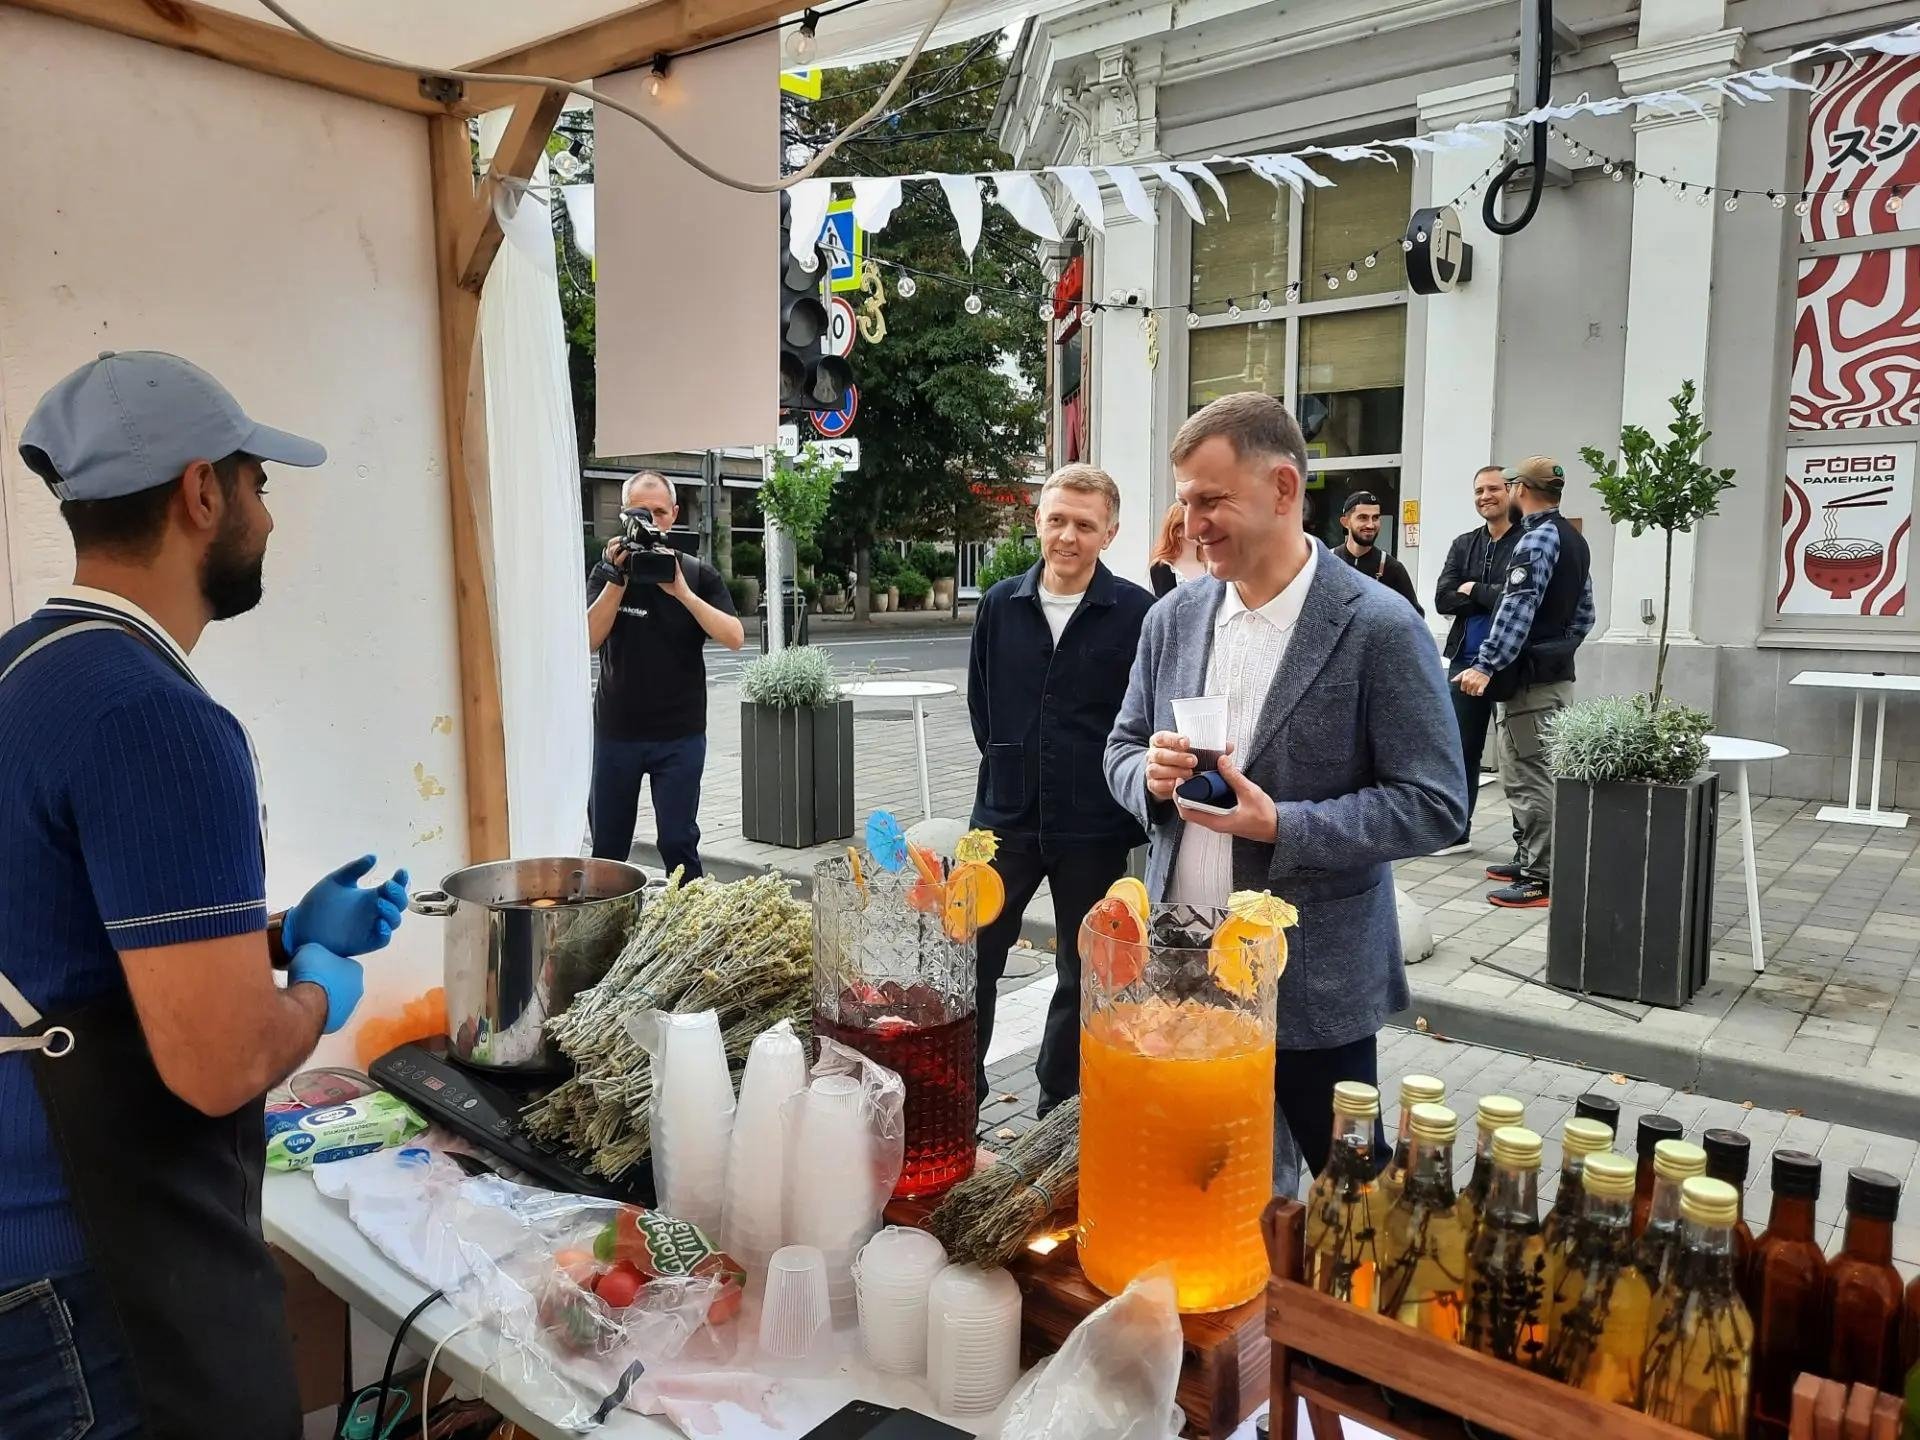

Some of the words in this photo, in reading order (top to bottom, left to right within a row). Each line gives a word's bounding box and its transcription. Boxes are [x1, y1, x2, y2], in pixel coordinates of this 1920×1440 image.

[1827, 125, 1919, 170] スシ
[1803, 473, 1896, 485] РАМЕННАЯ
[286, 1136, 313, 1147] AURA
[287, 1156, 310, 1168] 120
[645, 1217, 686, 1275] Global
